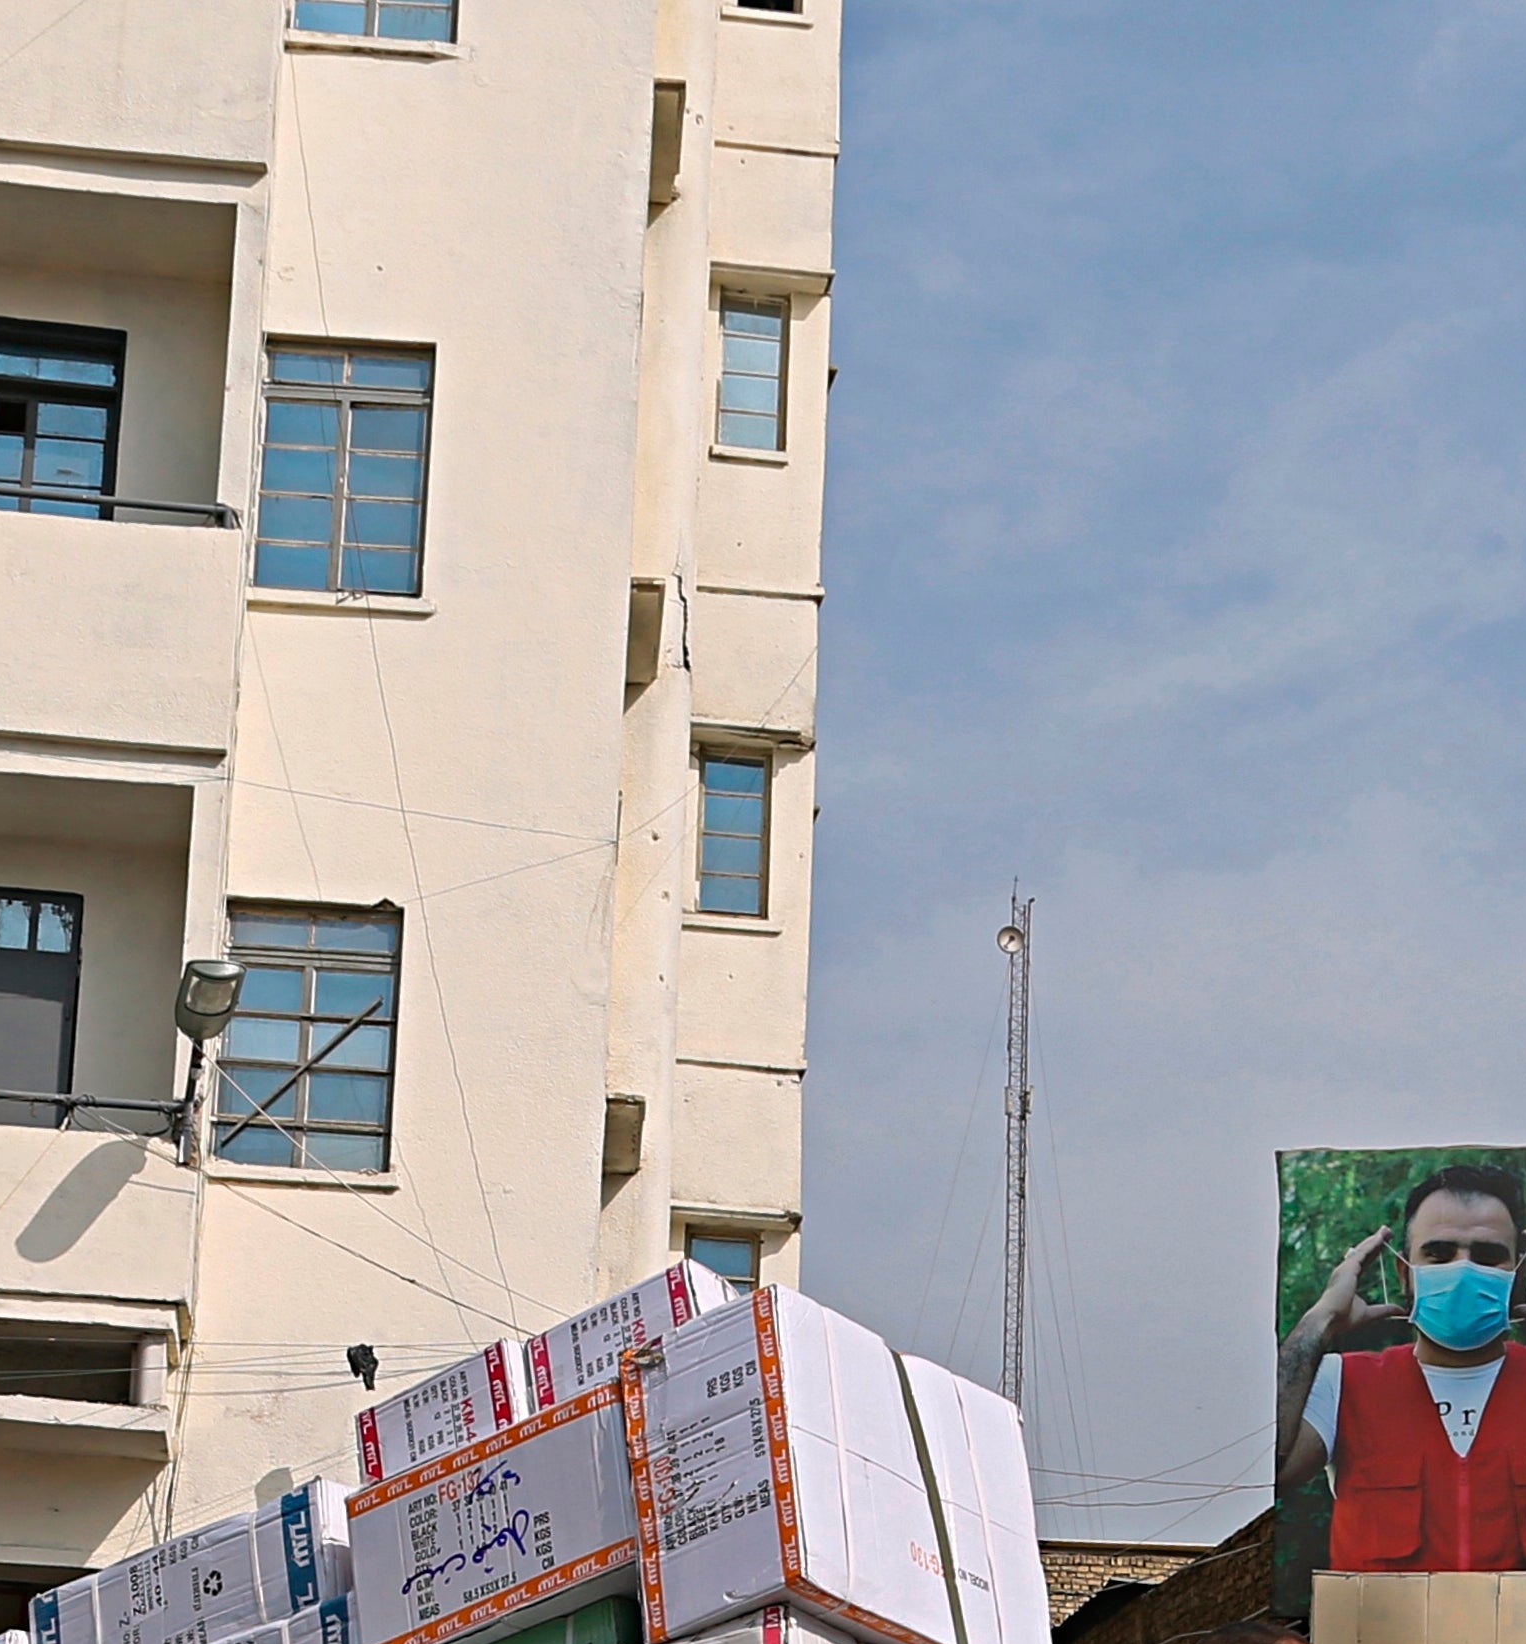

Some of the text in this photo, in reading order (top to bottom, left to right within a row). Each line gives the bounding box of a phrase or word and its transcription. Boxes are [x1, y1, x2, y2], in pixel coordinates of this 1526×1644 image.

[732, 1365, 745, 1389] KGS
[745, 1360, 758, 1377] CM
[707, 1376, 719, 1399] PRS
[719, 1370, 731, 1394] KGS
[759, 1478, 772, 1509] MEAS
[407, 1500, 424, 1515] ART
[411, 1511, 551, 1543] BLACK PRS
[534, 1527, 552, 1543] KGS
[535, 1541, 553, 1557] KGS
[418, 1555, 555, 1622] MEAS CM
